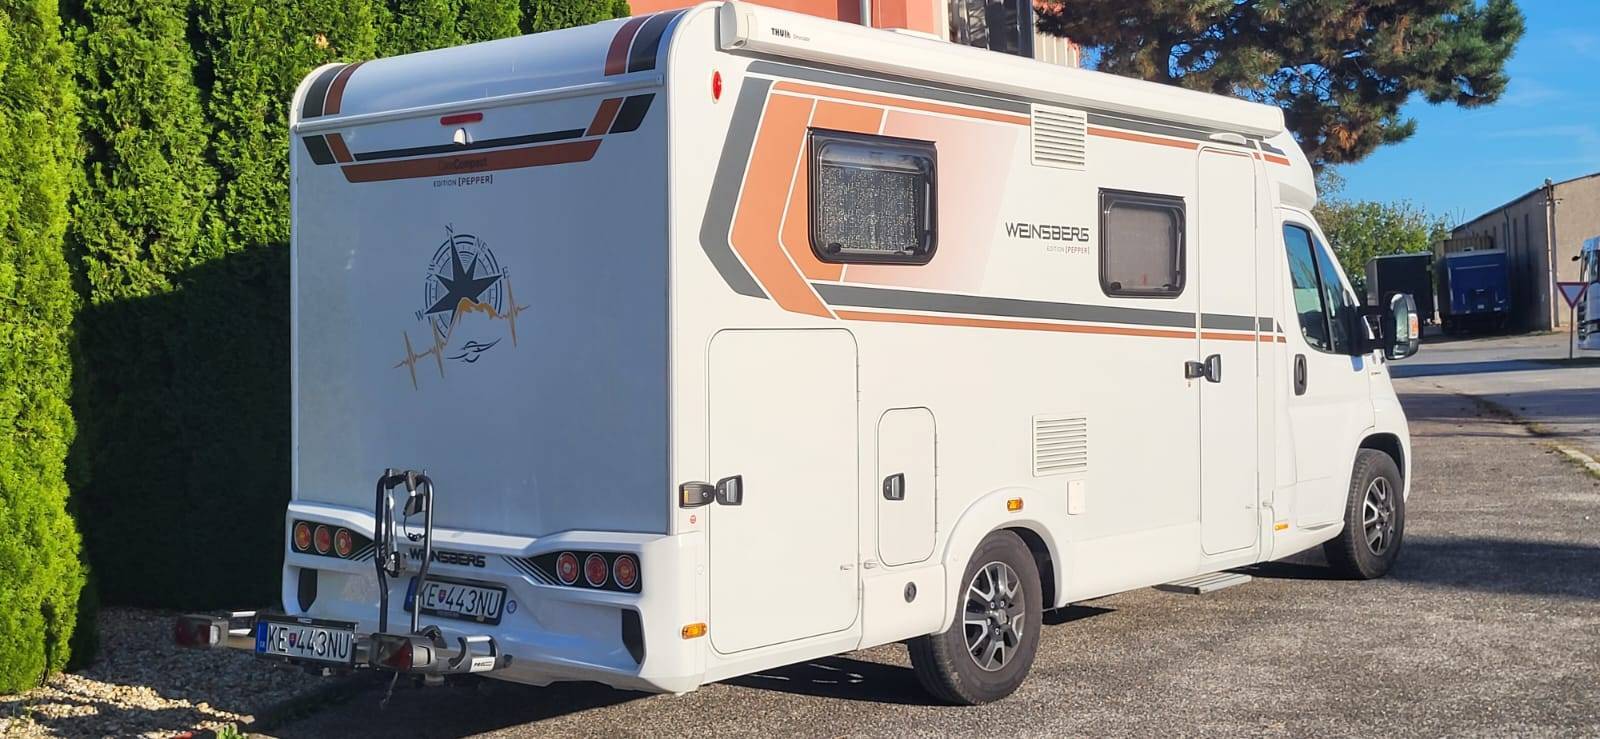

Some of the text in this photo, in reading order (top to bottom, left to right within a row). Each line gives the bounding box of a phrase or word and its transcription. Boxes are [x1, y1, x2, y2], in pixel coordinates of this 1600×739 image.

[433, 178, 457, 187] EDITION
[1005, 222, 1090, 242] WEINSBERG
[267, 624, 350, 659] KE 443NU
